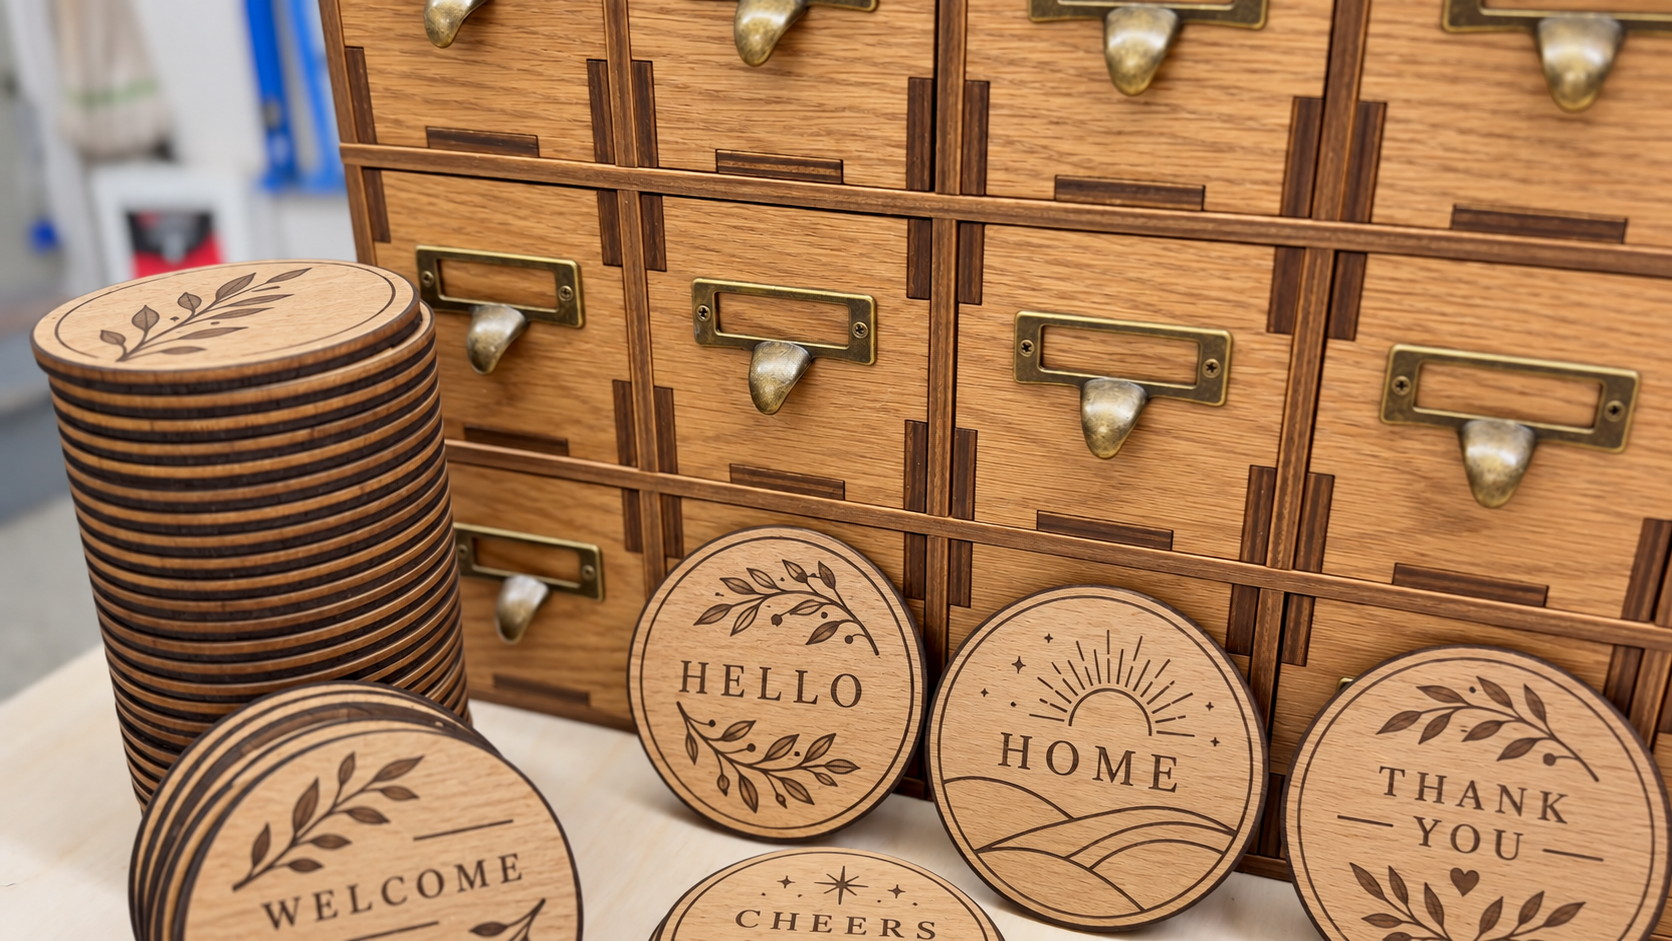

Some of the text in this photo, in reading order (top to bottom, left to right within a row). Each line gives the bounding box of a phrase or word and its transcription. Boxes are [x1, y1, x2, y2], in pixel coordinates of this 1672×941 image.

[678, 660, 862, 708] HELLO
[998, 732, 1178, 793] HOME
[1379, 766, 1568, 824] THANK
[1413, 815, 1524, 860] YOU
[261, 853, 523, 931] WELCOME
[735, 909, 936, 940] CHEERS
